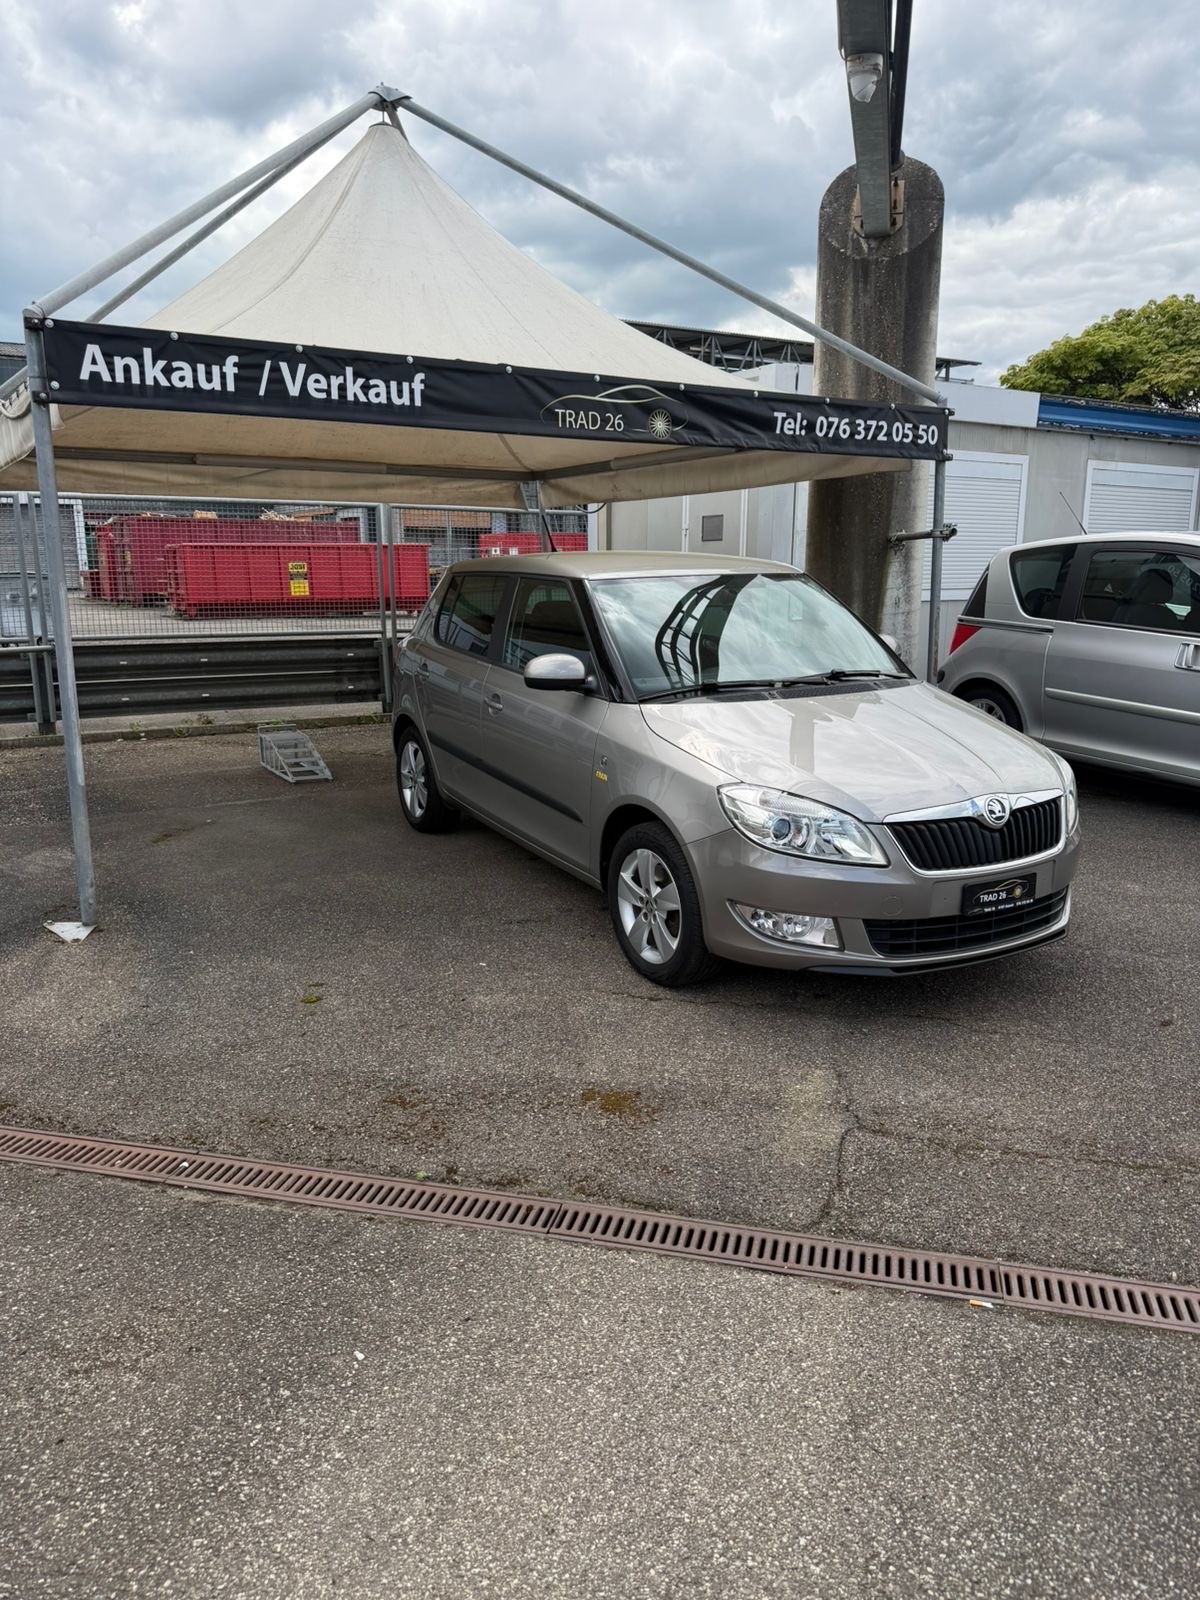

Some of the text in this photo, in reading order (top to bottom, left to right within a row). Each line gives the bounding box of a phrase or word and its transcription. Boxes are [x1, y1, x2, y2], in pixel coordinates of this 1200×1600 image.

[80, 343, 239, 392] Ankauf
[555, 408, 624, 432] TRAD 26
[774, 412, 939, 445] Tel: 076 372 05 50
[980, 891, 1007, 903] TRAD 26
